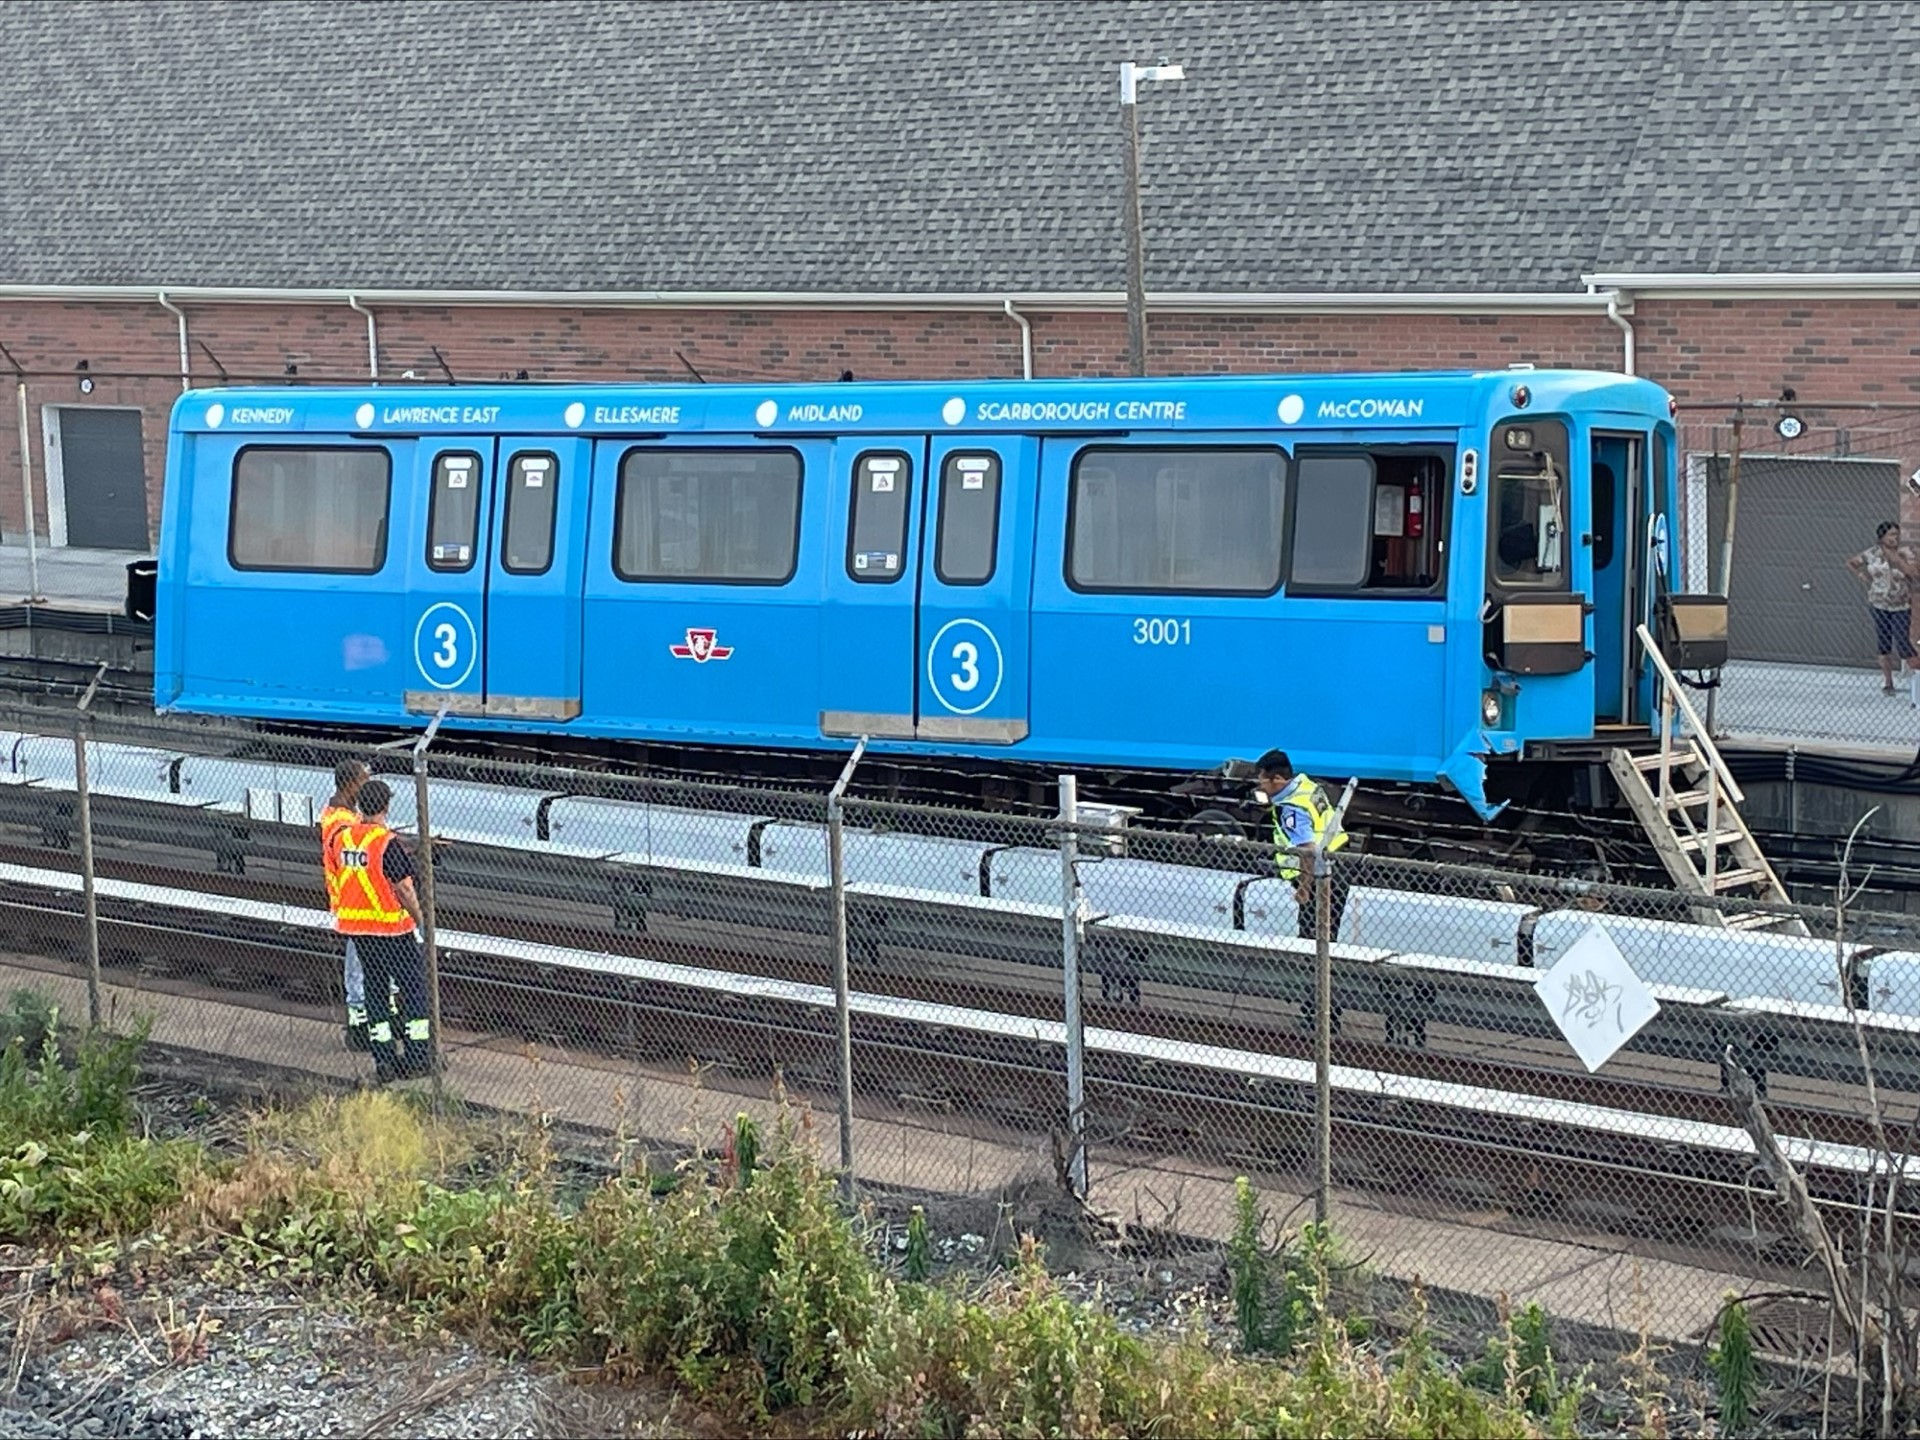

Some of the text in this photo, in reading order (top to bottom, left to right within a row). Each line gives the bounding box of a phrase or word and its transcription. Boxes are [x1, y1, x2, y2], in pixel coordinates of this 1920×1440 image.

[231, 408, 294, 424] KENNEDY
[382, 406, 500, 424] LAWRENCE EAST
[594, 406, 681, 424] ELLESMERE
[788, 404, 863, 422] MIDLAND
[977, 401, 1187, 421] SCARBOROUGH CENTRE
[1317, 399, 1424, 419] McCOWAN
[1132, 618, 1191, 645] 3001
[433, 623, 458, 668] 3
[950, 641, 980, 692] 3
[342, 850, 368, 867] TTC
